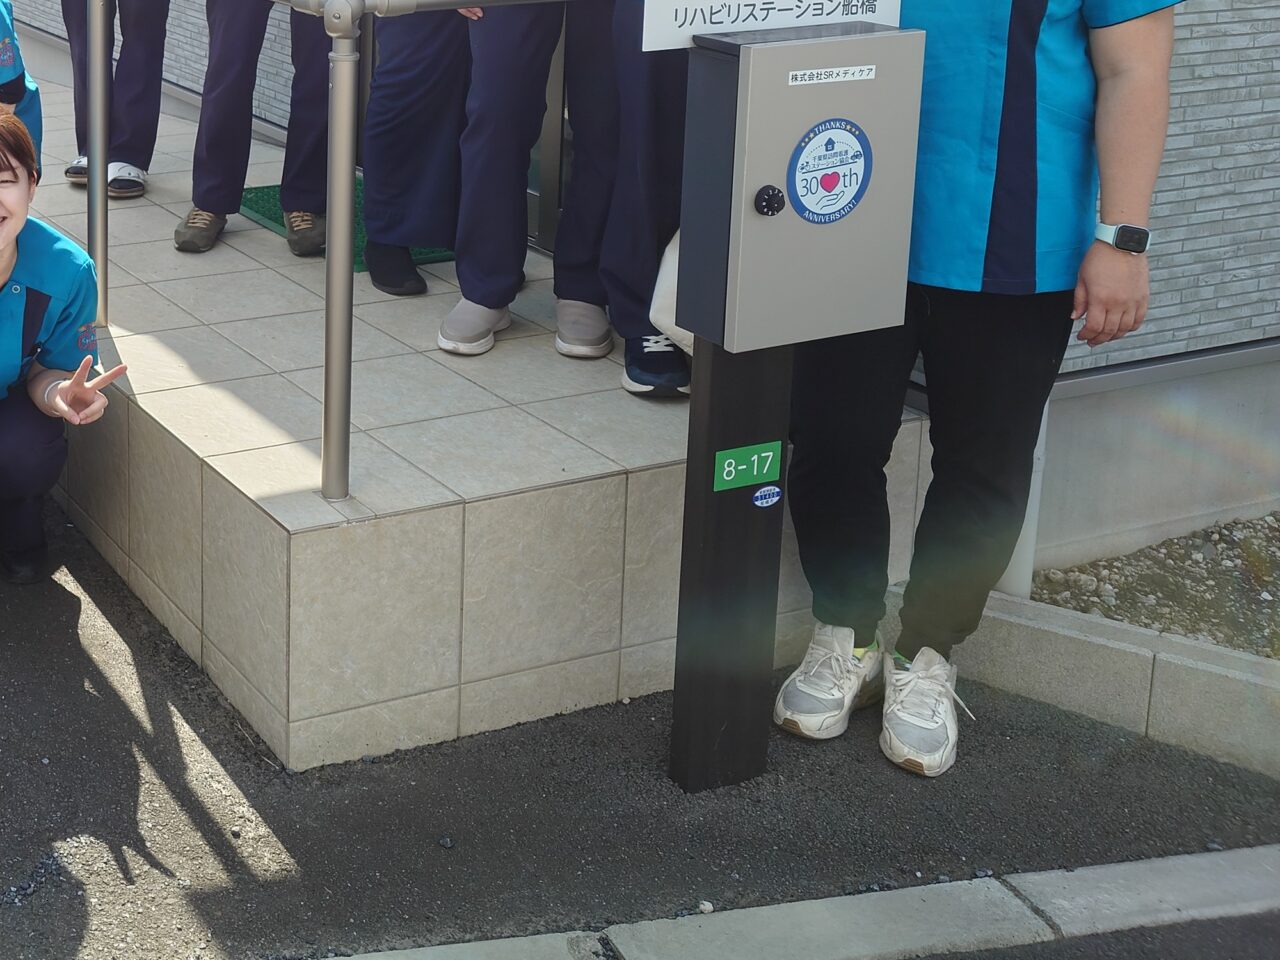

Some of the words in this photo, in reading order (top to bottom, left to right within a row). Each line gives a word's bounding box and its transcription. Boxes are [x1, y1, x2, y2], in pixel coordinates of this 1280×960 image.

[790, 67, 874, 83] 株式会社SRメディケア
[814, 121, 847, 135] THANKS
[800, 176, 819, 198] 30
[841, 167, 859, 188] th
[803, 199, 857, 223] ANNIVERSARY!
[722, 451, 774, 481] 8-17
